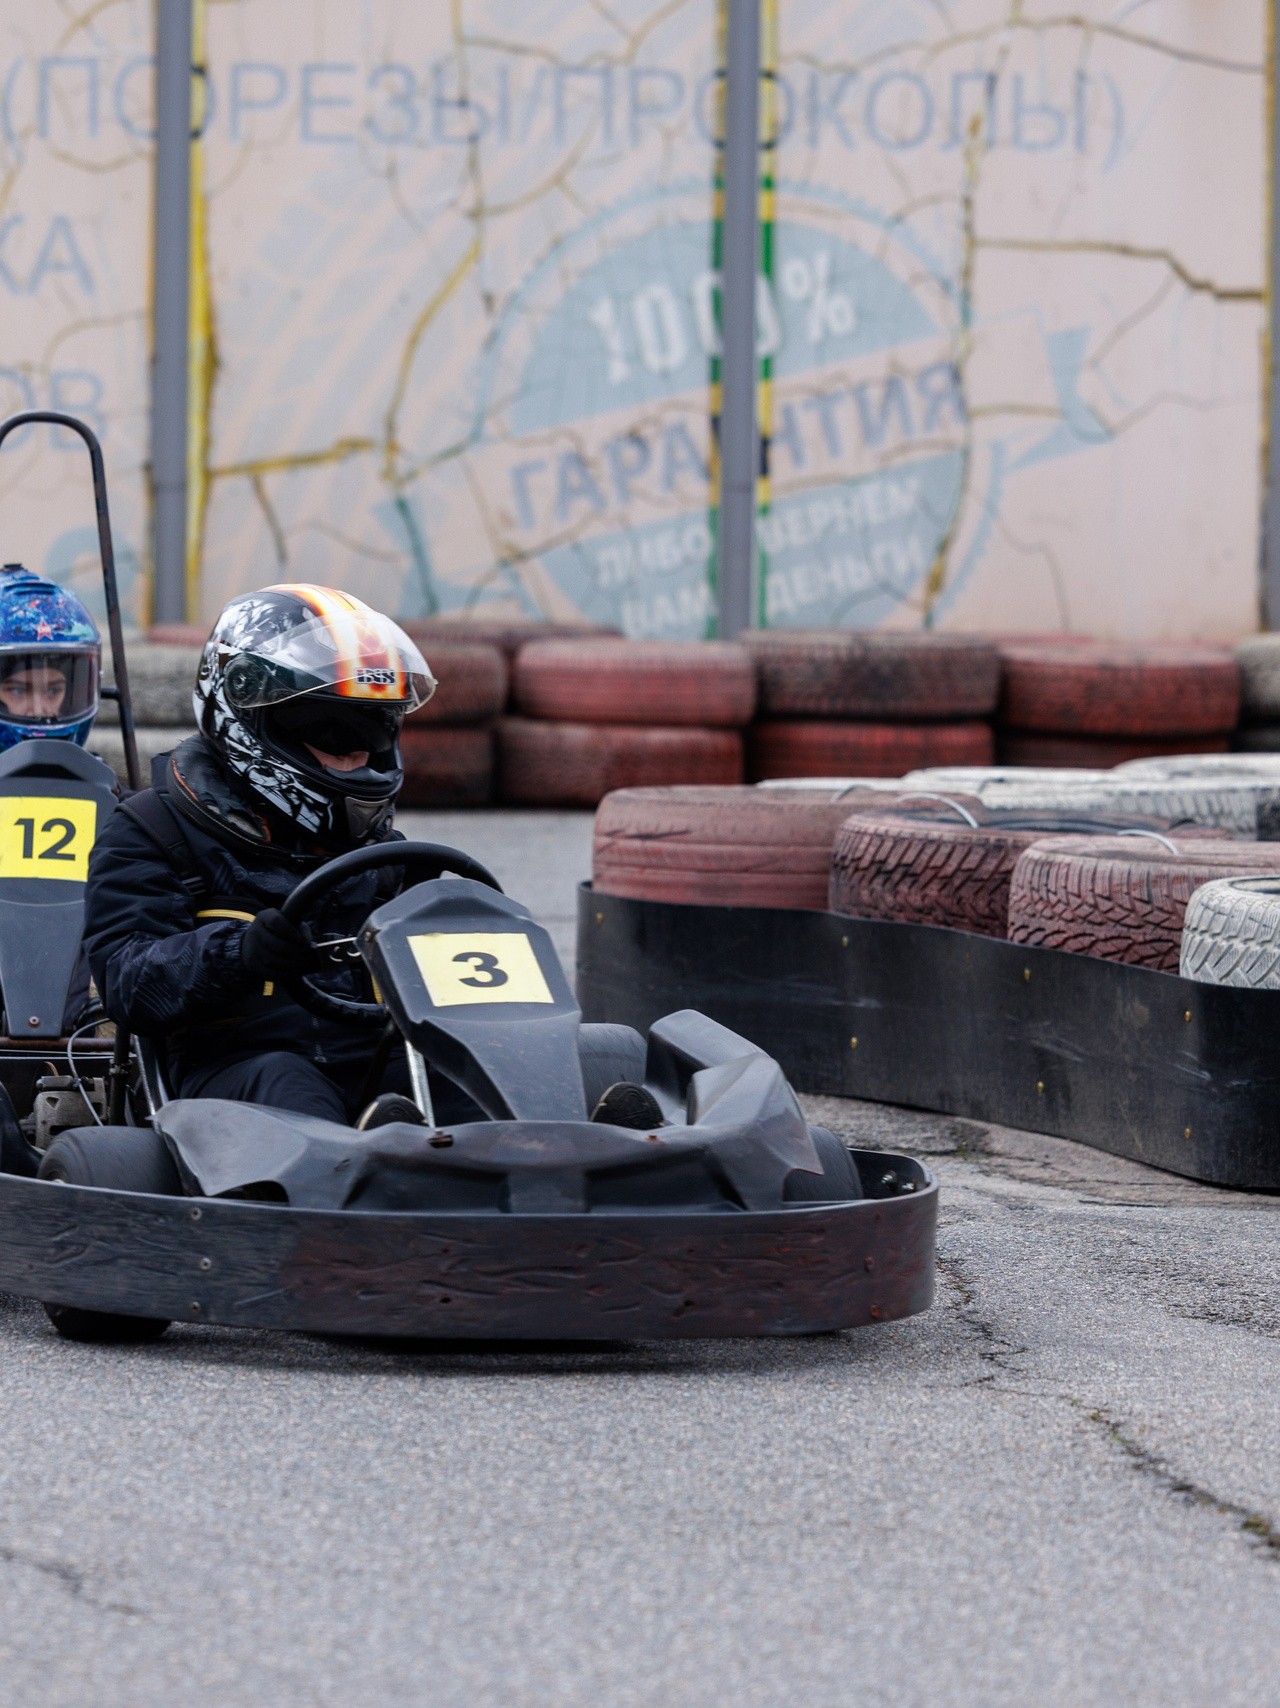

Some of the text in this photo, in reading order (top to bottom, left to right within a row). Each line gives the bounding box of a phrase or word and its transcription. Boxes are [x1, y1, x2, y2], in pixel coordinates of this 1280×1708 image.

[510, 360, 968, 531] ГАРАНТИЯ
[14, 818, 77, 861] 12
[452, 951, 509, 988] 3
